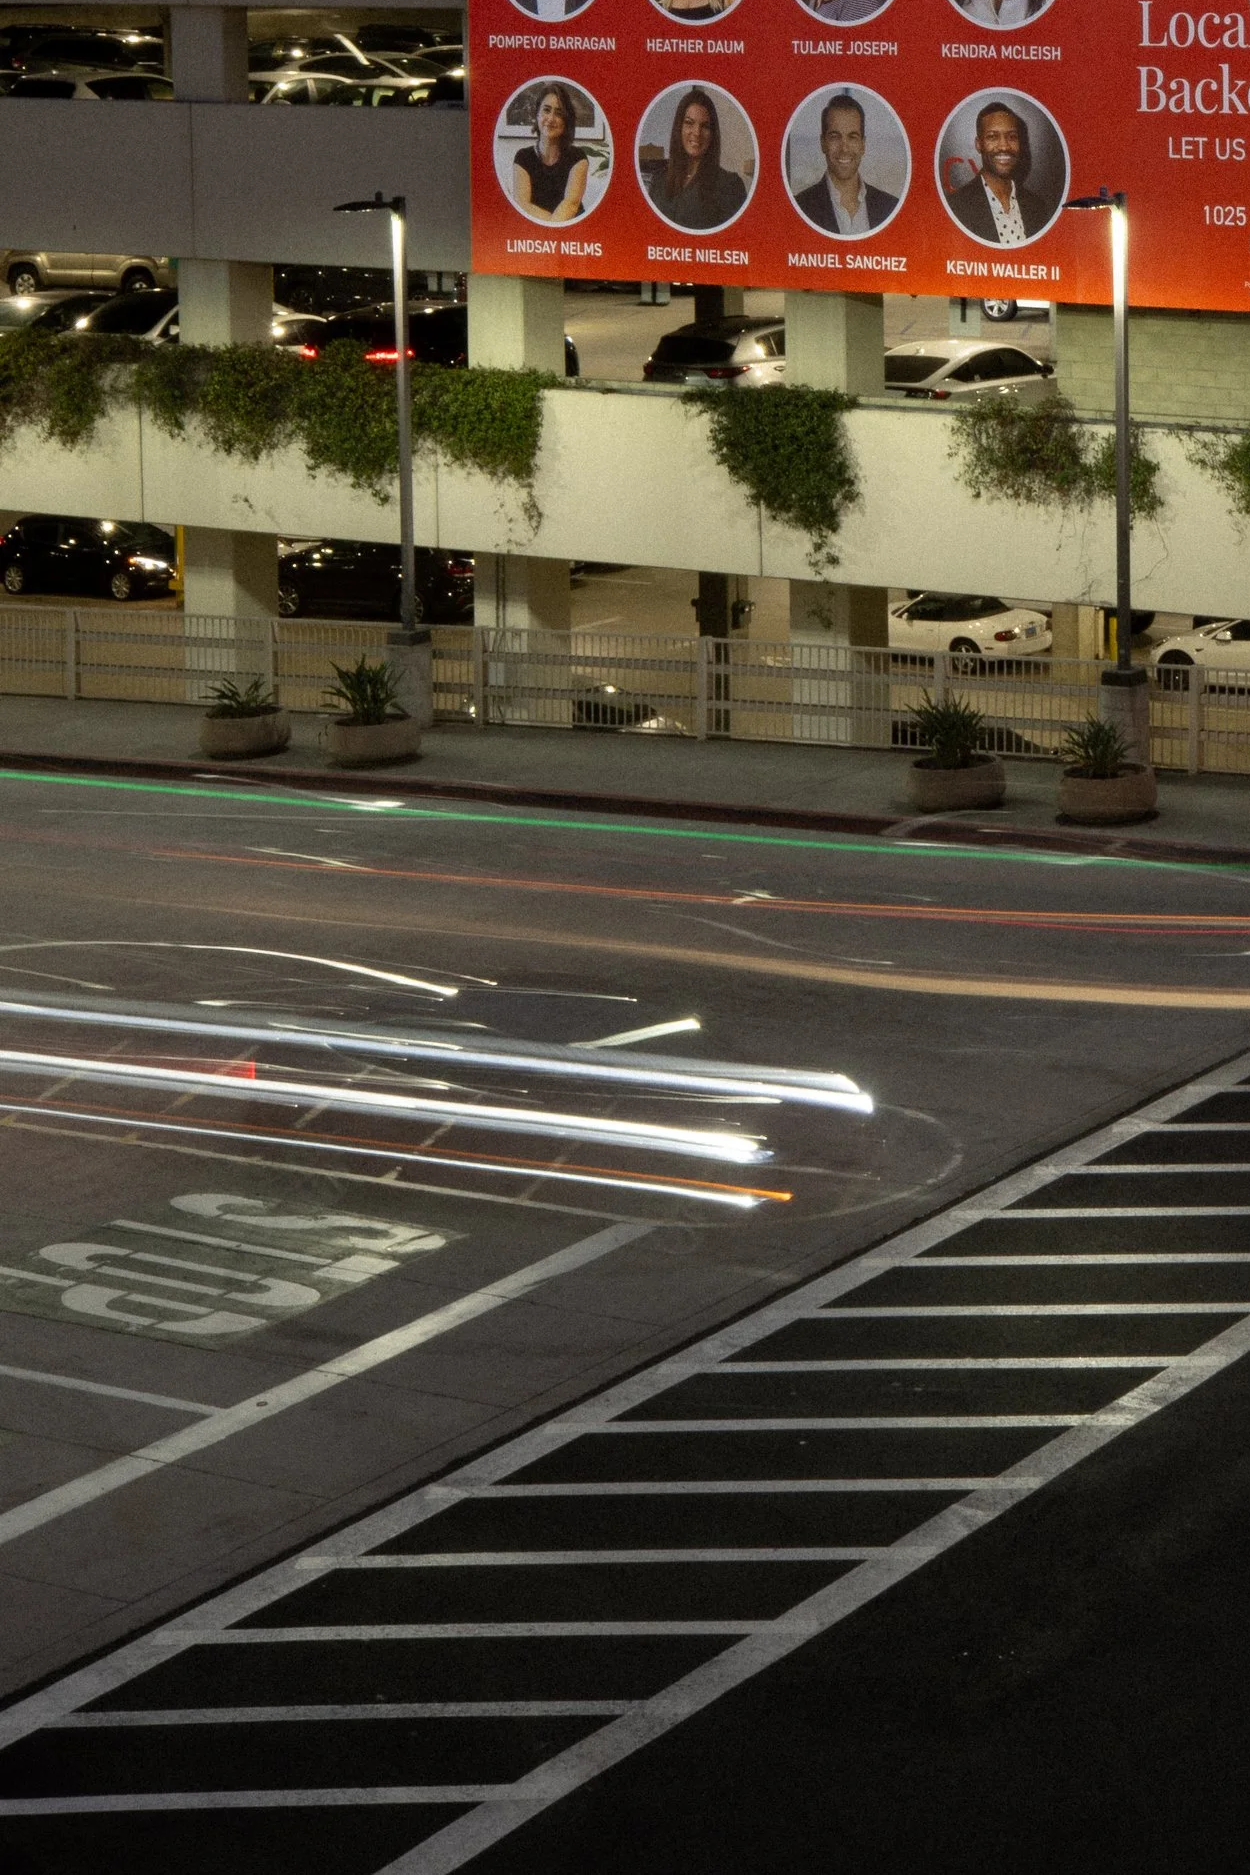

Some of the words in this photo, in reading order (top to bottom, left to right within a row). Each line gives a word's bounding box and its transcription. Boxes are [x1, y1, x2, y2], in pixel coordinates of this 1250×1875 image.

[489, 35, 546, 49] POMPEYO
[550, 36, 615, 50] BARRAGAN
[647, 39, 703, 52] HEATHER
[708, 40, 744, 53] DAUM
[792, 41, 843, 54] TULANE
[847, 41, 897, 55] JOSEPH
[942, 44, 997, 58] KENDRA
[1001, 45, 1061, 60] MCLEISH
[1169, 137, 1208, 159] LET
[1216, 138, 1245, 160] US
[1204, 205, 1246, 226] 1025
[507, 240, 557, 253] LINDSAY
[561, 242, 602, 256] NELMS
[648, 246, 692, 261] BECKIE
[696, 249, 748, 264] NIELSEN
[788, 253, 842, 268] MANUEL
[846, 255, 906, 271] SANCHEZ
[947, 260, 987, 276] KEVIN
[992, 263, 1047, 279] WALLER
[1051, 267, 1059, 280] II
